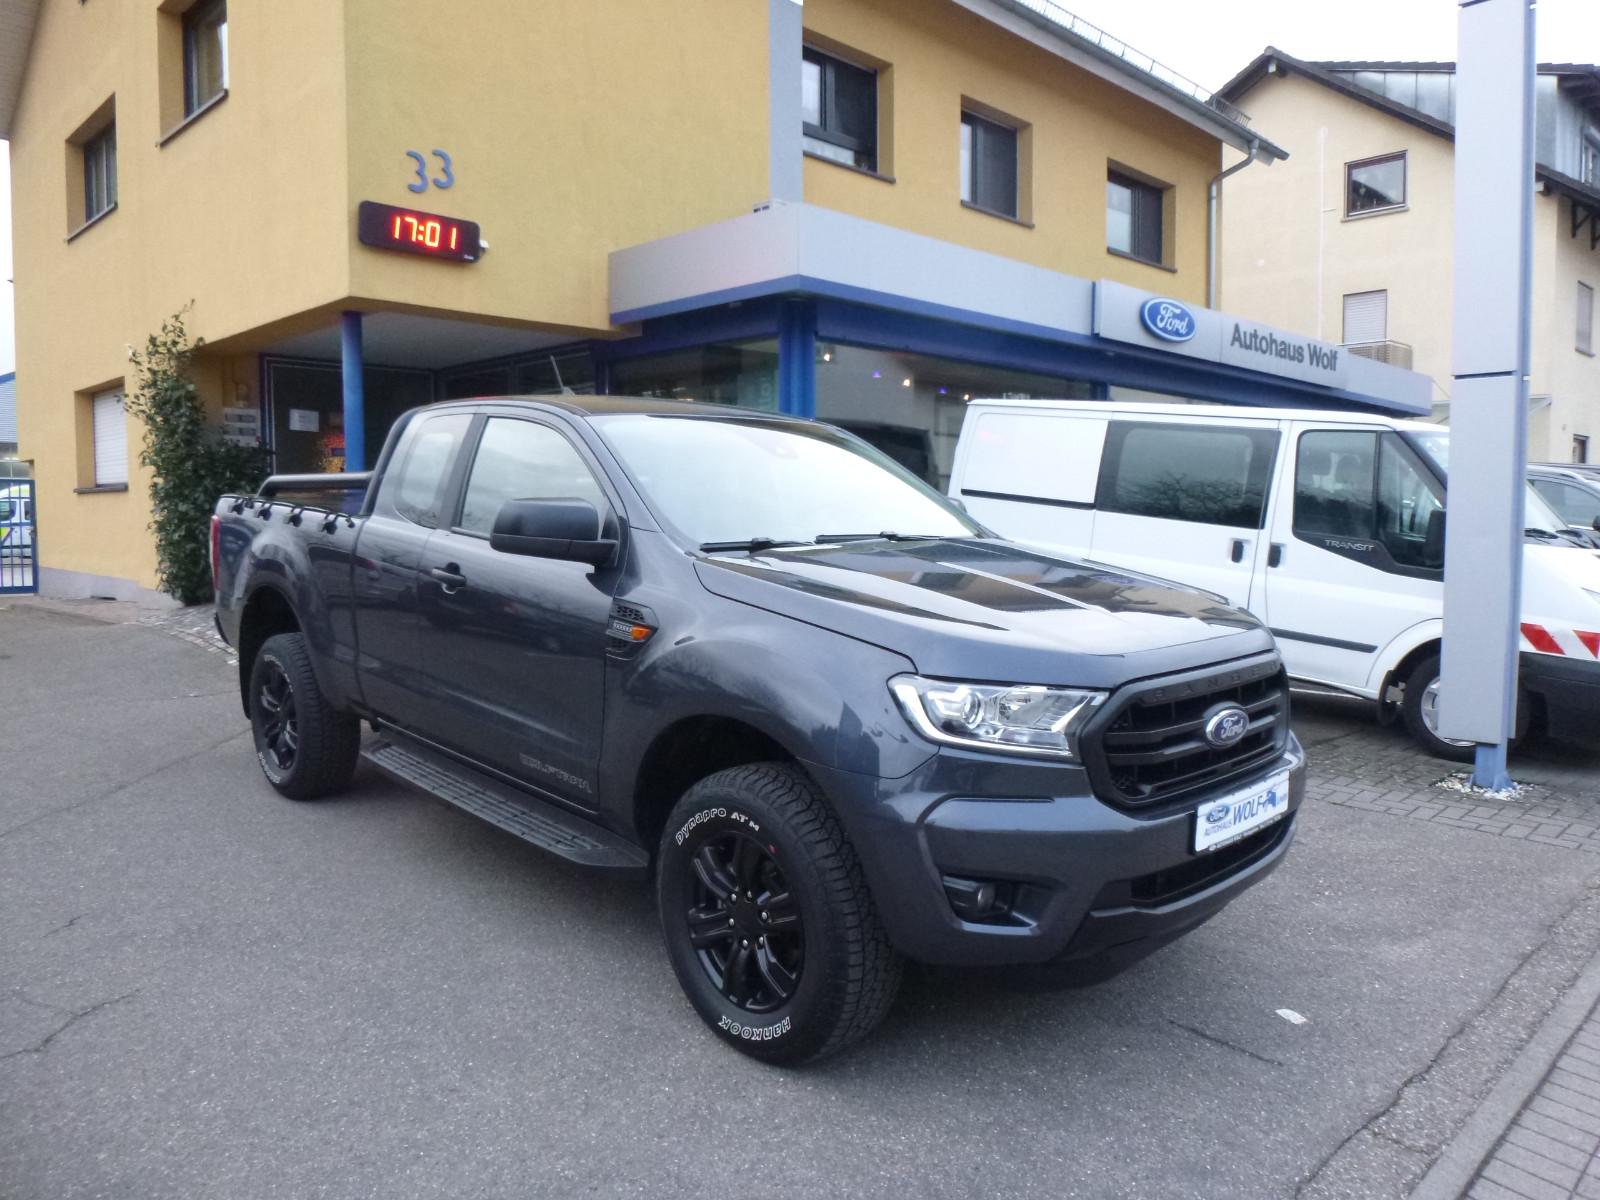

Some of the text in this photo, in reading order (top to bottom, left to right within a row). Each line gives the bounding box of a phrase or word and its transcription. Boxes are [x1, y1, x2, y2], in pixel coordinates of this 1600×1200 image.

[406, 149, 454, 193] 33
[393, 215, 457, 250] 17:01
[1156, 303, 1190, 335] Ford
[1230, 323, 1338, 372] Autohaus Wolf
[1325, 540, 1375, 552] TRANSIT
[1220, 715, 1246, 739] Ford
[675, 808, 727, 846] Dynapro
[1233, 795, 1262, 826] WOLF
